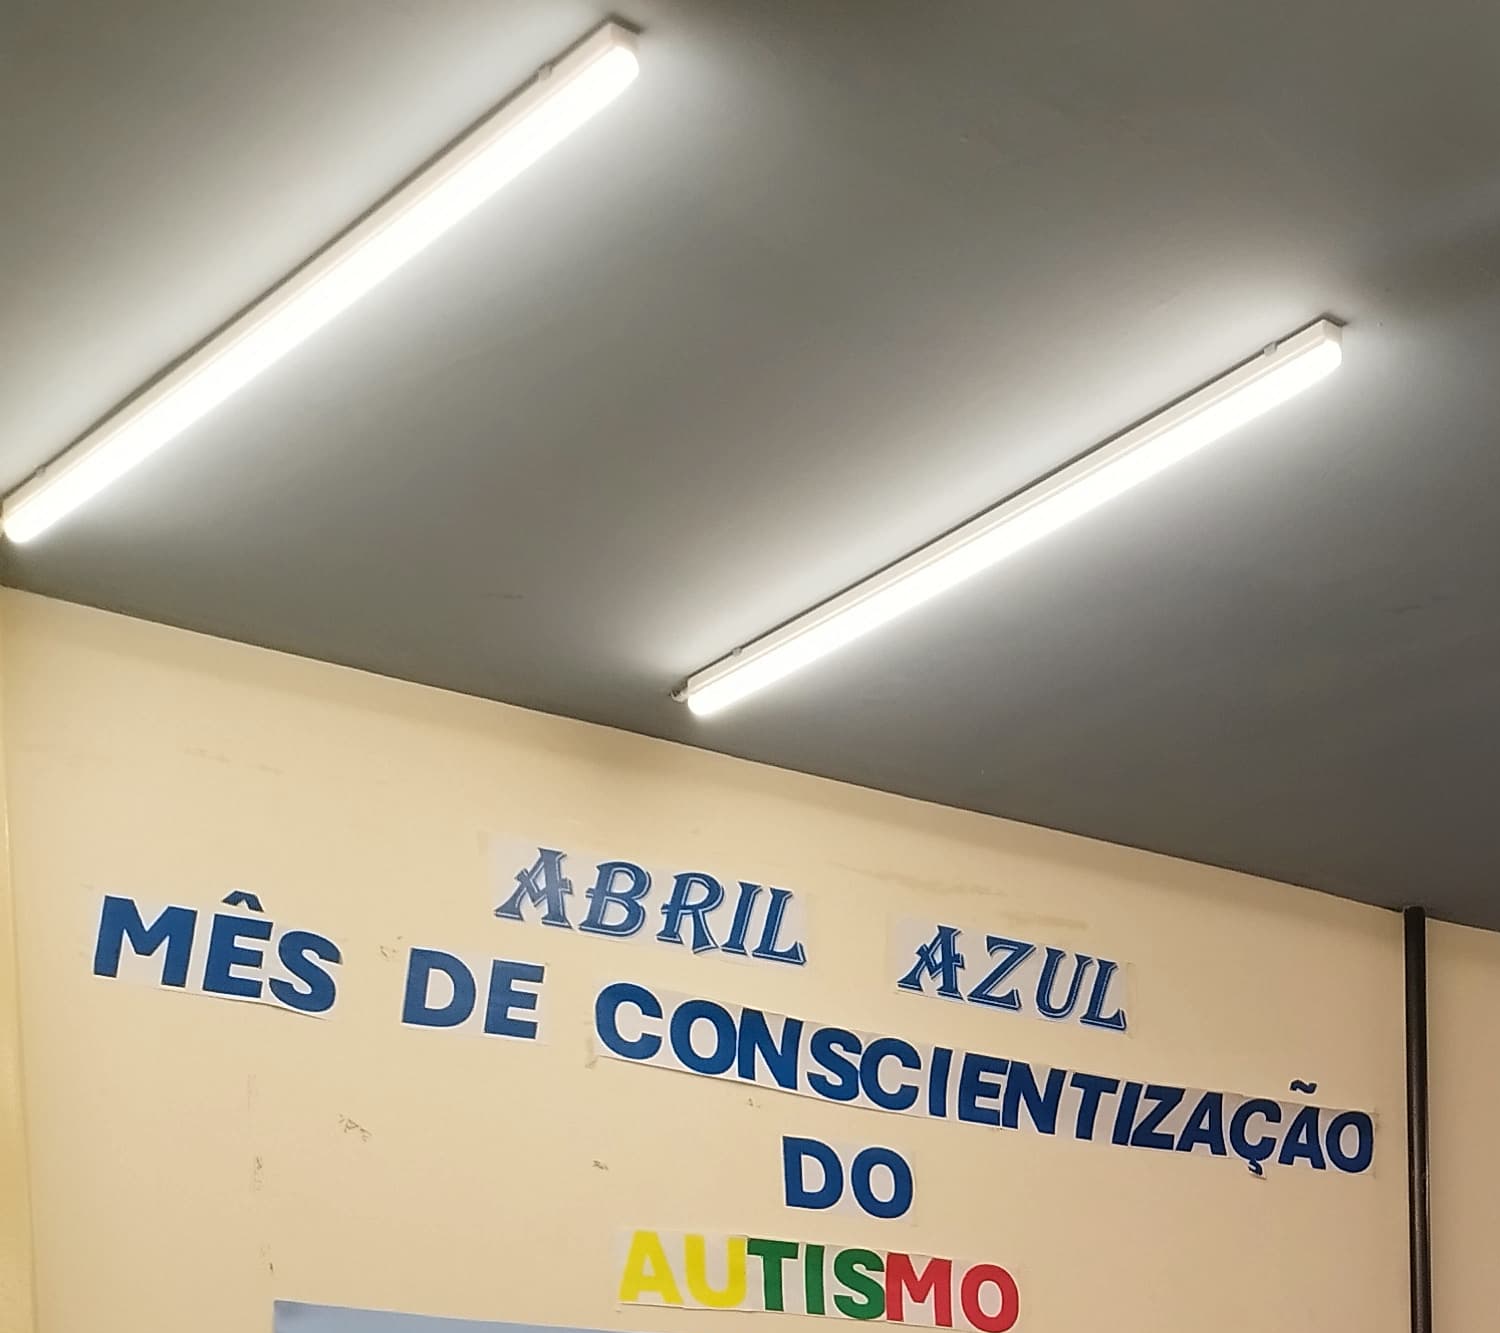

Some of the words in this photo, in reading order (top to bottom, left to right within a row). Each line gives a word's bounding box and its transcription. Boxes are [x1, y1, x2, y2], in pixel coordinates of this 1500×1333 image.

[494, 847, 807, 967] ABRIL
[898, 925, 1127, 1031] AZUL
[94, 891, 342, 1012] MÊS
[401, 948, 546, 1040] DE
[595, 983, 1374, 1175] CONSCIENTIZAÇÃO
[782, 1136, 913, 1219] DO
[619, 1230, 1020, 1333] AUTISMO
